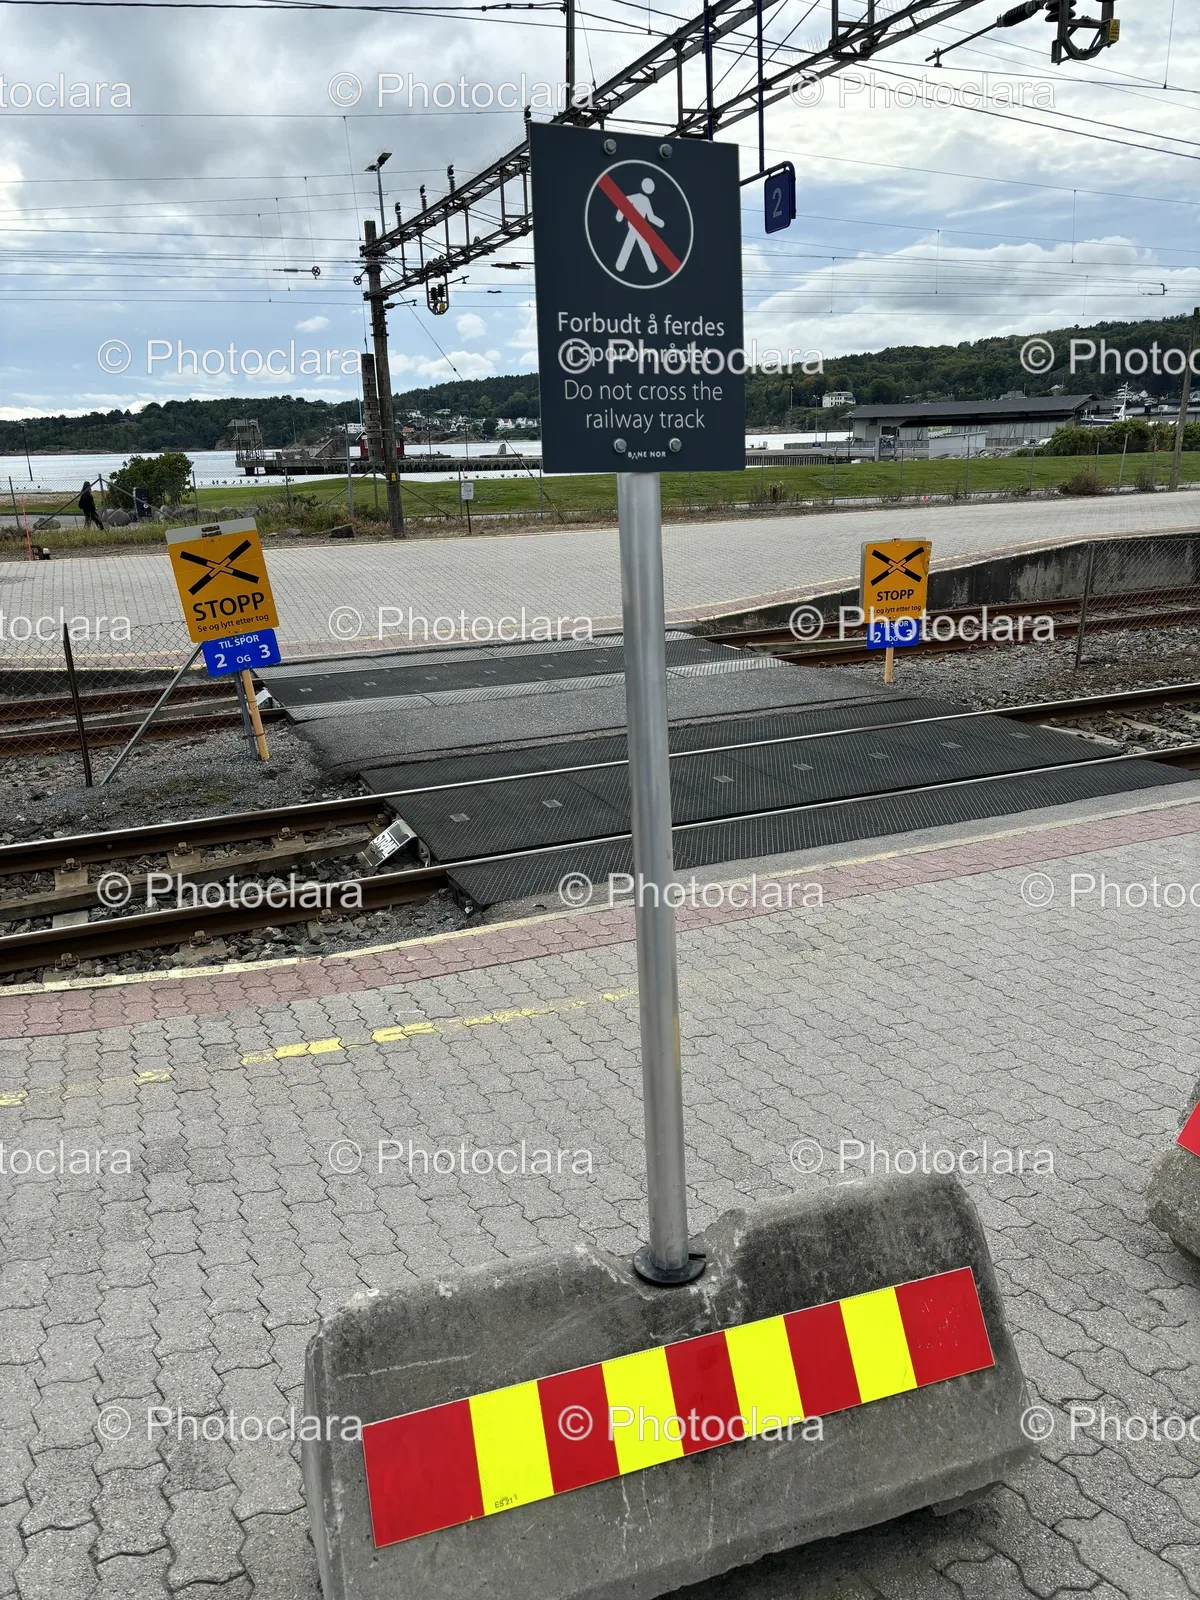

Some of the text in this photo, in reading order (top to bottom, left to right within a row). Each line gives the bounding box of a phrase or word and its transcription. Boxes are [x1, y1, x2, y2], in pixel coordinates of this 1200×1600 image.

[772, 187, 783, 218] 2
[558, 312, 725, 336] Forbudt å ferdes
[564, 379, 723, 401] Do not cross the
[586, 408, 706, 434] railway track
[876, 588, 915, 602] STOPP
[192, 592, 265, 622] STOPP
[198, 614, 270, 633] Se og lytt etter tog
[218, 634, 260, 650] TIL SPOR
[873, 631, 882, 644] 2
[214, 644, 271, 668] 2 OG 3
